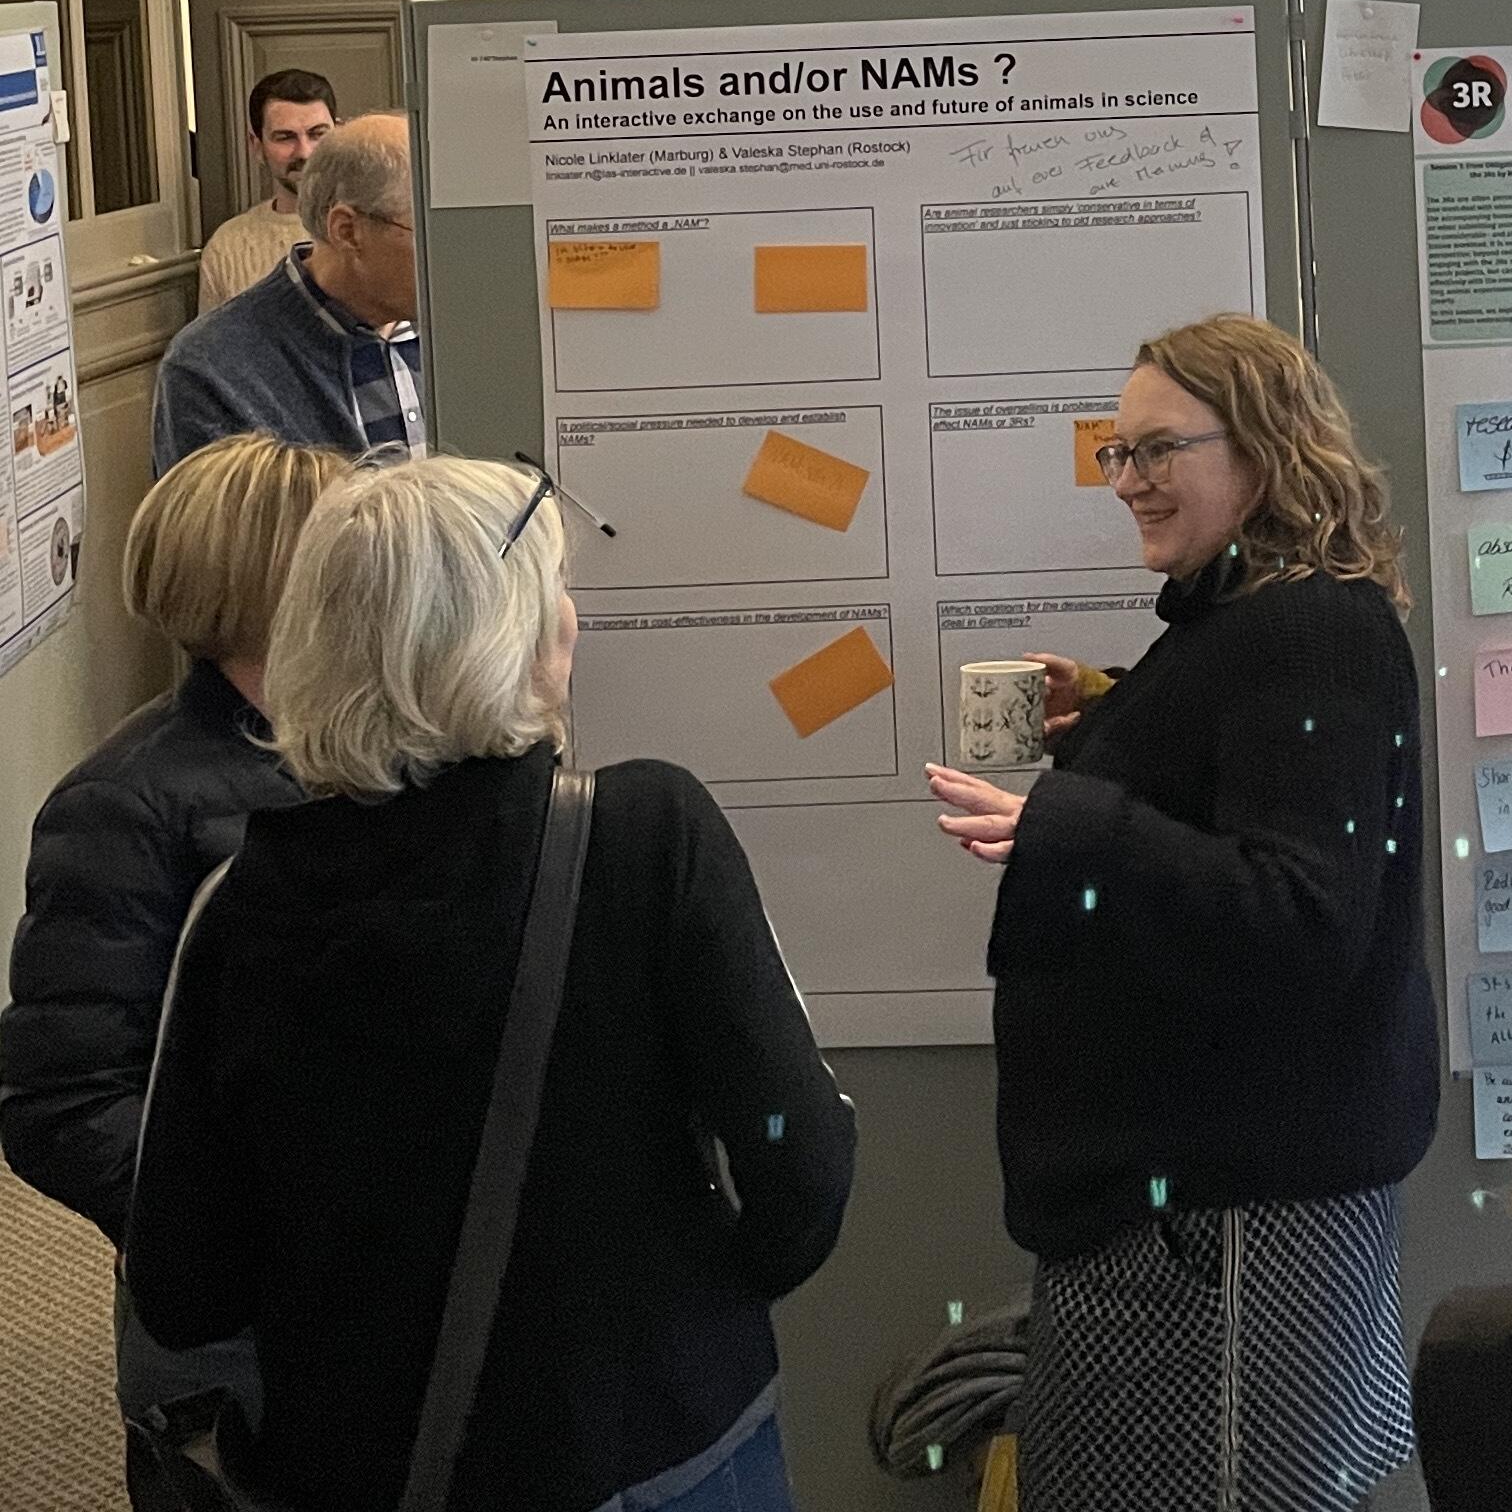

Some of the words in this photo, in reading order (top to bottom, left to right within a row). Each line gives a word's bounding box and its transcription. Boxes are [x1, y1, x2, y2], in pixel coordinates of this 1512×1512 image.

[542, 66, 704, 104] Animals
[719, 61, 848, 97] and/or
[861, 55, 979, 90] NAMs
[993, 53, 1017, 85] ?
[1452, 81, 1493, 108] 3R
[543, 114, 569, 131] An
[575, 109, 676, 129] interactive
[683, 106, 776, 127] exchange
[782, 108, 806, 121] on
[812, 104, 843, 120] the
[849, 104, 884, 118] use
[890, 99, 926, 117] and
[932, 96, 989, 115] future
[995, 95, 1015, 112] of
[1020, 93, 1095, 111] animals
[1101, 91, 1119, 108] in
[1124, 89, 1199, 107] science
[545, 153, 585, 166] Nicole
[589, 151, 645, 165] Linklater
[649, 148, 714, 164] (Marburg)
[718, 146, 728, 160] &
[731, 145, 784, 159] Valeska
[787, 143, 843, 160] Stephan
[847, 141, 911, 157] (Rostock)
[1074, 134, 1184, 172] Feedback
[550, 223, 575, 234] What
[577, 221, 611, 233] makes
[622, 220, 659, 231] method
[933, 406, 951, 417] The
[954, 405, 980, 416] issue
[983, 404, 994, 415] of
[1051, 402, 1060, 413] is
[963, 419, 993, 429] NAMs
[996, 419, 1007, 428] or
[1009, 416, 1035, 427] 3Rs?
[941, 604, 971, 615] Which
